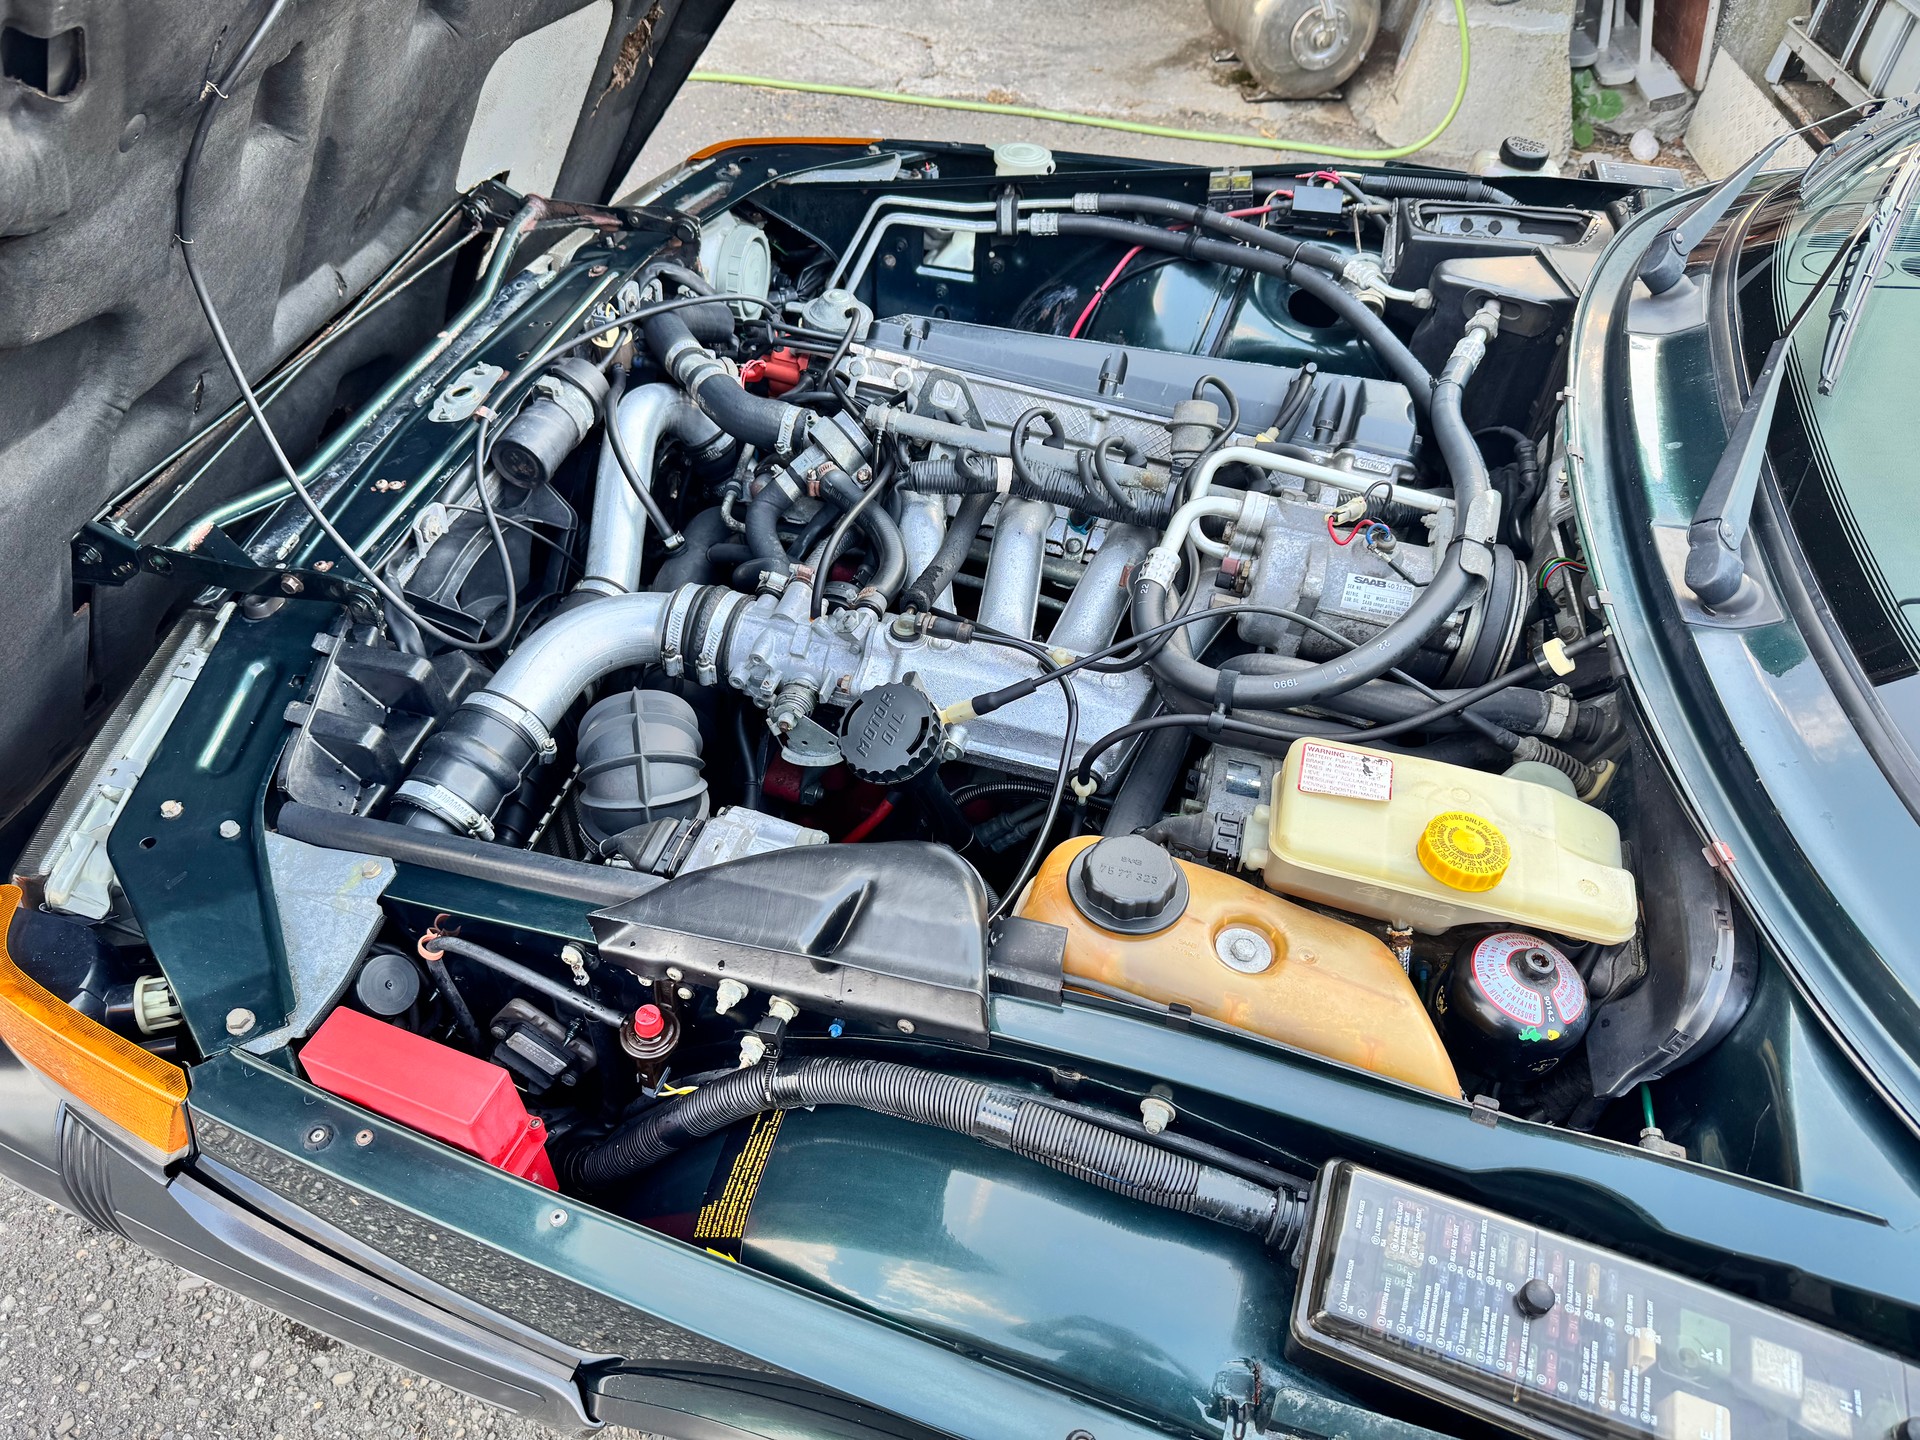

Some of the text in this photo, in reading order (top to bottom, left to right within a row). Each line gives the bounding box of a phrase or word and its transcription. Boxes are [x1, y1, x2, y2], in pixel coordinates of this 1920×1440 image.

[1140, 583, 1149, 594] 22
[1353, 575, 1387, 588] SAAB
[1274, 639, 1391, 690] 22 11 1990
[856, 691, 892, 757] MOTOR
[882, 713, 906, 746] OIL
[1307, 745, 1345, 757] WARNING
[1448, 859, 1462, 869] CAP
[1465, 816, 1483, 826] ONLY
[1135, 872, 1158, 884] 323
[1477, 961, 1486, 977] FLUID
[1489, 989, 1504, 1003] HIGH
[1505, 1003, 1536, 1021] PRESSURE
[1487, 955, 1499, 980] REMOVE
[1503, 989, 1536, 1011] CONTAINS
[1498, 964, 1537, 1001] NOT LOOSEN
[1355, 1199, 1366, 1228] SPARE FUSES
[1396, 1200, 1404, 1215] LIGHT
[694, 1207, 706, 1238] Caution!
[697, 1204, 712, 1237] Achtung!
[1479, 1233, 1487, 1249] LAMPS
[1468, 1250, 1477, 1268] RELAYS
[1476, 1250, 1485, 1271] CONTROL
[1487, 1246, 1498, 1275] DASH LIGHT
[1527, 1257, 1535, 1277] COOLING
[1341, 1258, 1354, 1301] LAMBDA SENSOR
[1565, 1259, 1575, 1303] HAZARD WARNING
[1379, 1291, 1389, 1315] IGNITION
[1401, 1287, 1411, 1311] RUNNING
[1427, 1302, 1437, 1332] WINDSHIELD
[1432, 1282, 1441, 1302] WASHER
[1440, 1290, 1451, 1327] CONDITIONING
[1585, 1293, 1593, 1309] CLOCK
[1625, 1293, 1634, 1311] PUMPS
[1645, 1299, 1654, 1314] LIGHT
[1419, 1299, 1429, 1330] WINDSHIELD
[1458, 1307, 1469, 1344] TURN SIGNALS
[1489, 1311, 1497, 1335] CONTROL
[1498, 1326, 1508, 1358] VENTILATION
[1520, 1335, 1528, 1351] LEVEL
[1582, 1346, 1590, 1362] LIGHT
[1590, 1340, 1598, 1362] LIGHTER
[1700, 1348, 1714, 1361] K
[1588, 1362, 1597, 1391] CIGARETTE
[1622, 1368, 1630, 1385] BEAM
[1630, 1375, 1639, 1392] BEAM
[1643, 1376, 1651, 1393] BEAM
[1629, 1393, 1637, 1406] HIGH
[1840, 1400, 1853, 1413] H
